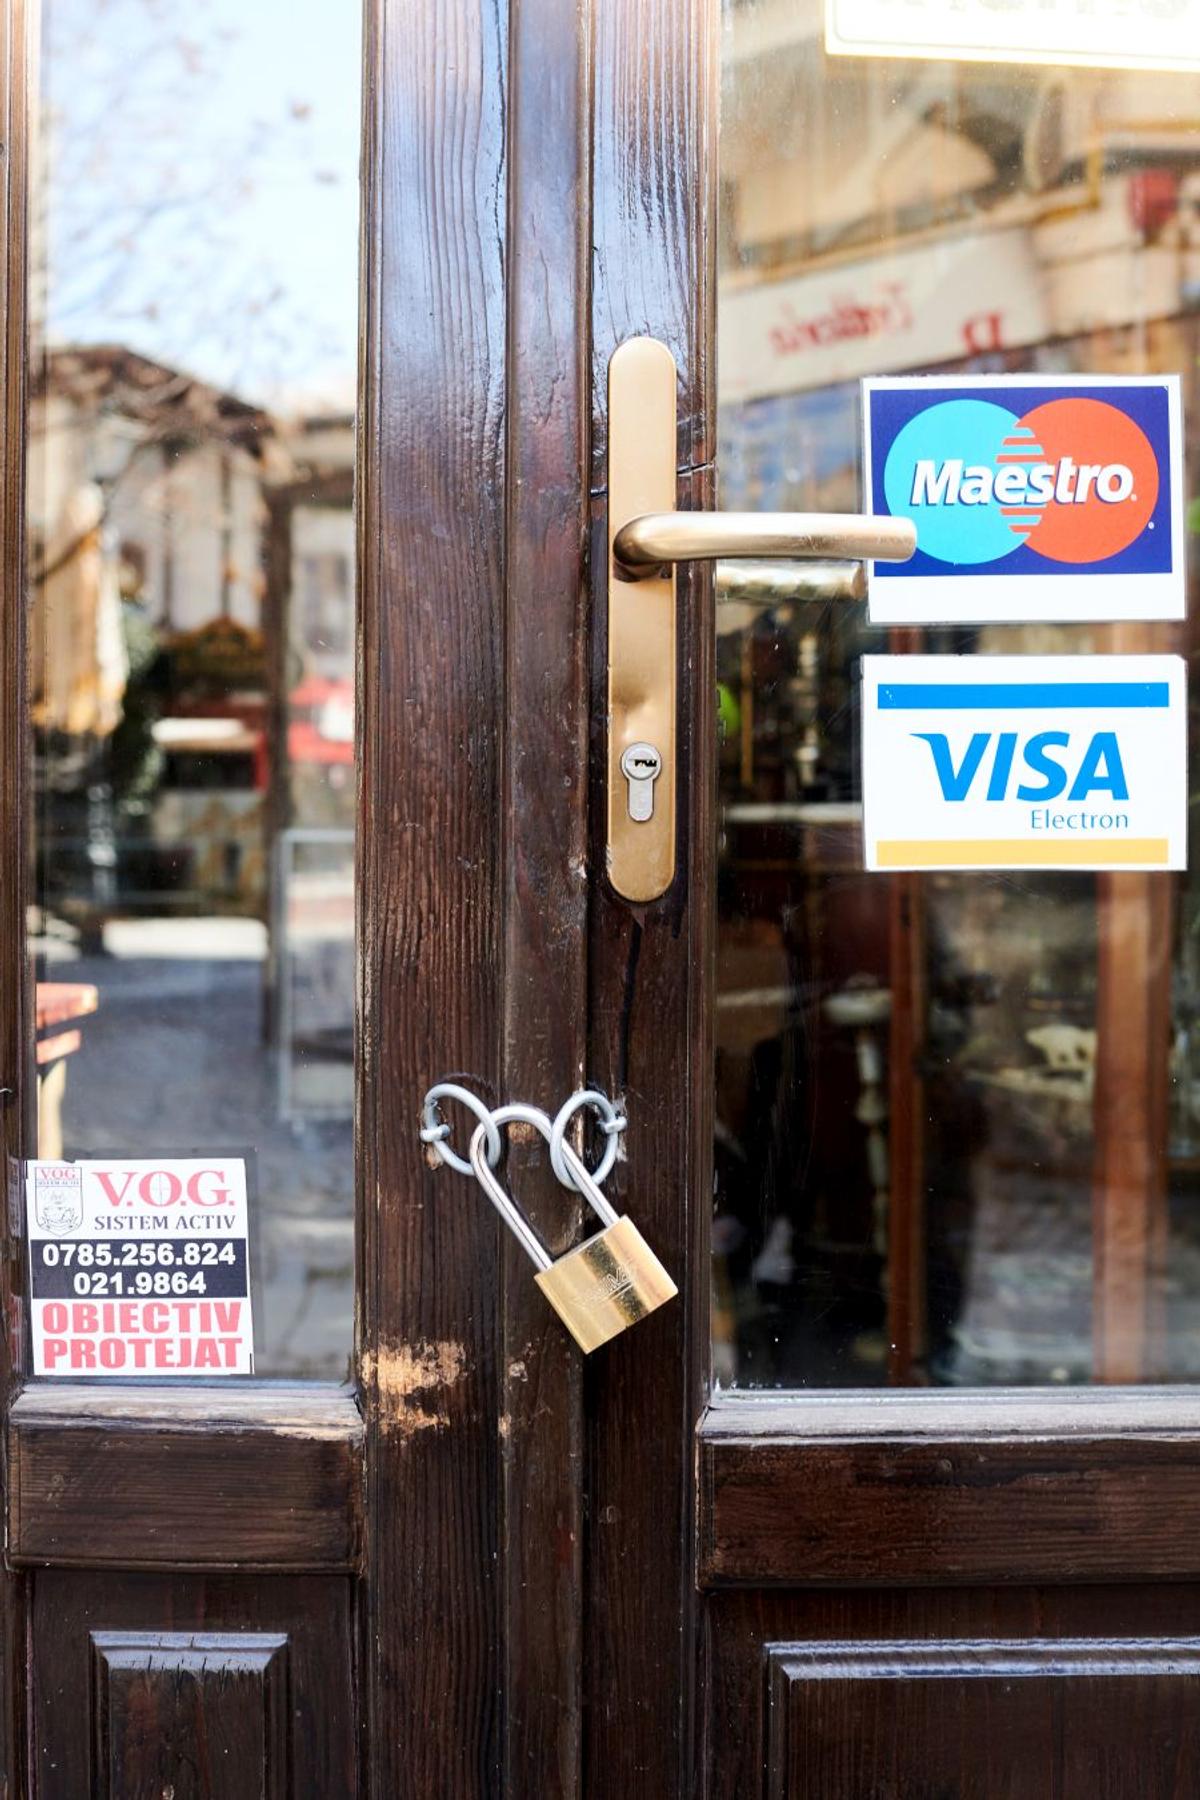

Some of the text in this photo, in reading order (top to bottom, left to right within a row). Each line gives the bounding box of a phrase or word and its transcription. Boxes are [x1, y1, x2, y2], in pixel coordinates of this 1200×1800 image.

[910, 456, 1134, 506] Maestro
[909, 731, 1130, 802] VISA
[1031, 809, 1129, 830] Electron
[92, 1170, 235, 1208] V.O.G.
[94, 1214, 236, 1231] SISTEM ACTIV
[42, 1242, 236, 1267] 0785.256.824
[73, 1271, 207, 1295] 021.9864
[42, 1301, 242, 1335] OBIECTIV
[43, 1337, 243, 1369] PROTEJAT
